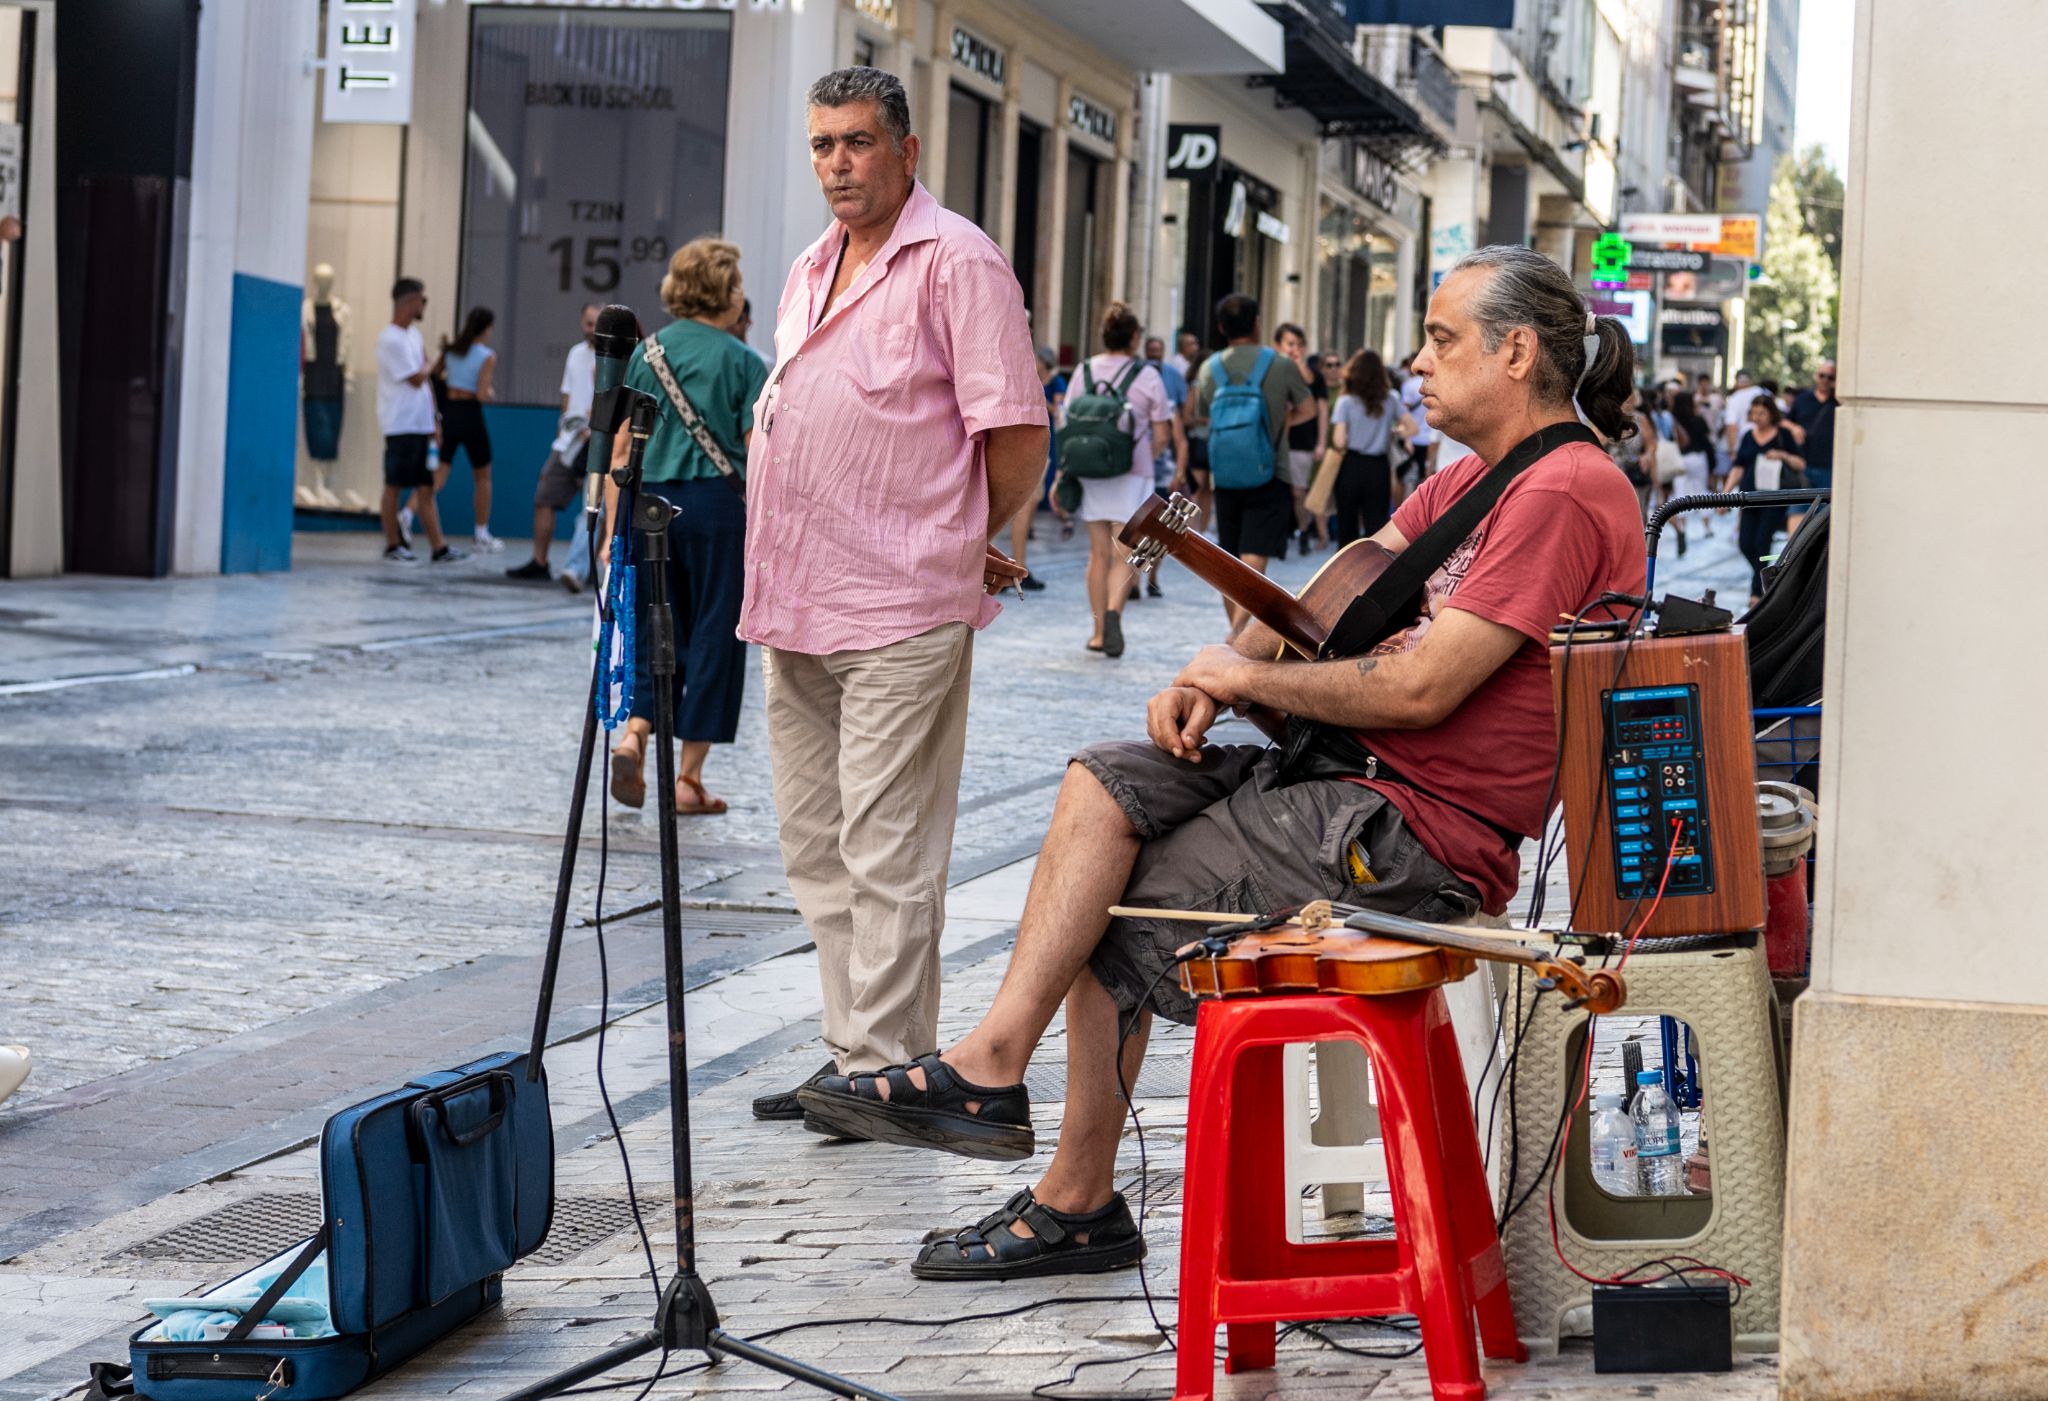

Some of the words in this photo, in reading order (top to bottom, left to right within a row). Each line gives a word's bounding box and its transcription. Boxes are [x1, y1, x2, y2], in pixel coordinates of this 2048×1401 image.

[340, 0, 393, 90] TE
[525, 81, 573, 106] BACK
[580, 83, 602, 108] TO
[606, 84, 675, 110] SCHOOL
[1168, 133, 1217, 170] JD
[568, 201, 624, 222] TZIN
